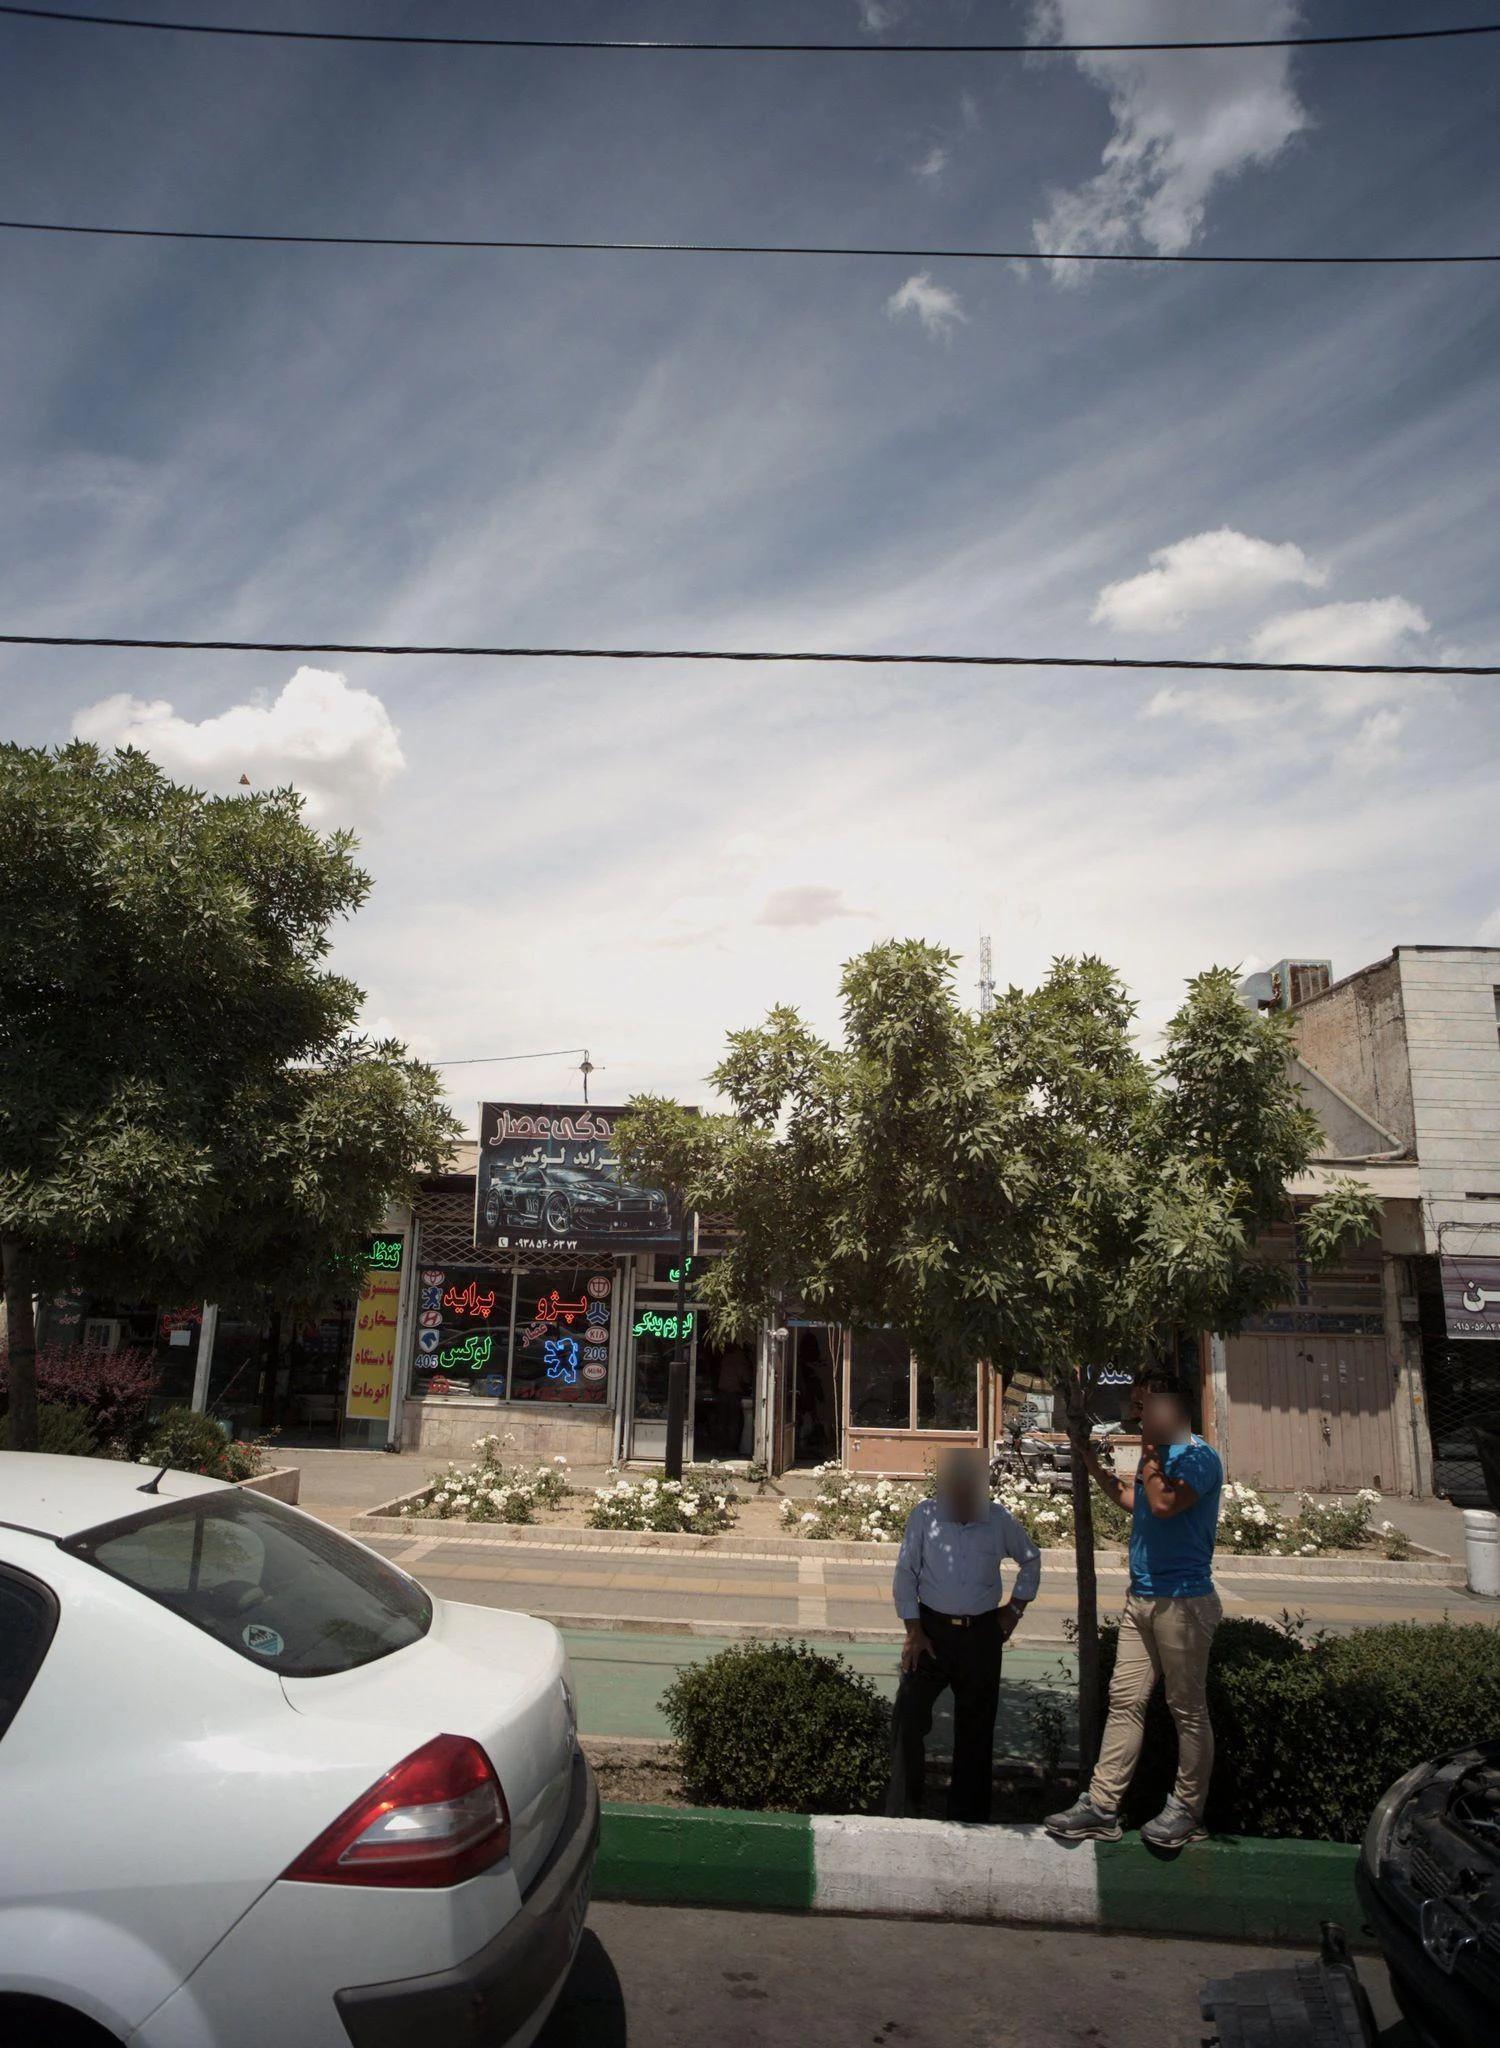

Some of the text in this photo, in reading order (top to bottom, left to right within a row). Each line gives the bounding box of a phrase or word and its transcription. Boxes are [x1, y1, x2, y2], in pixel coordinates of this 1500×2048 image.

[489, 1109, 551, 1146] عصار
[512, 1146, 566, 1169] لوکس
[443, 1282, 495, 1318] پراید
[535, 1290, 588, 1324] پژو
[416, 1354, 439, 1369] 405
[440, 1336, 492, 1369] لوکس
[583, 1346, 608, 1361] 206
